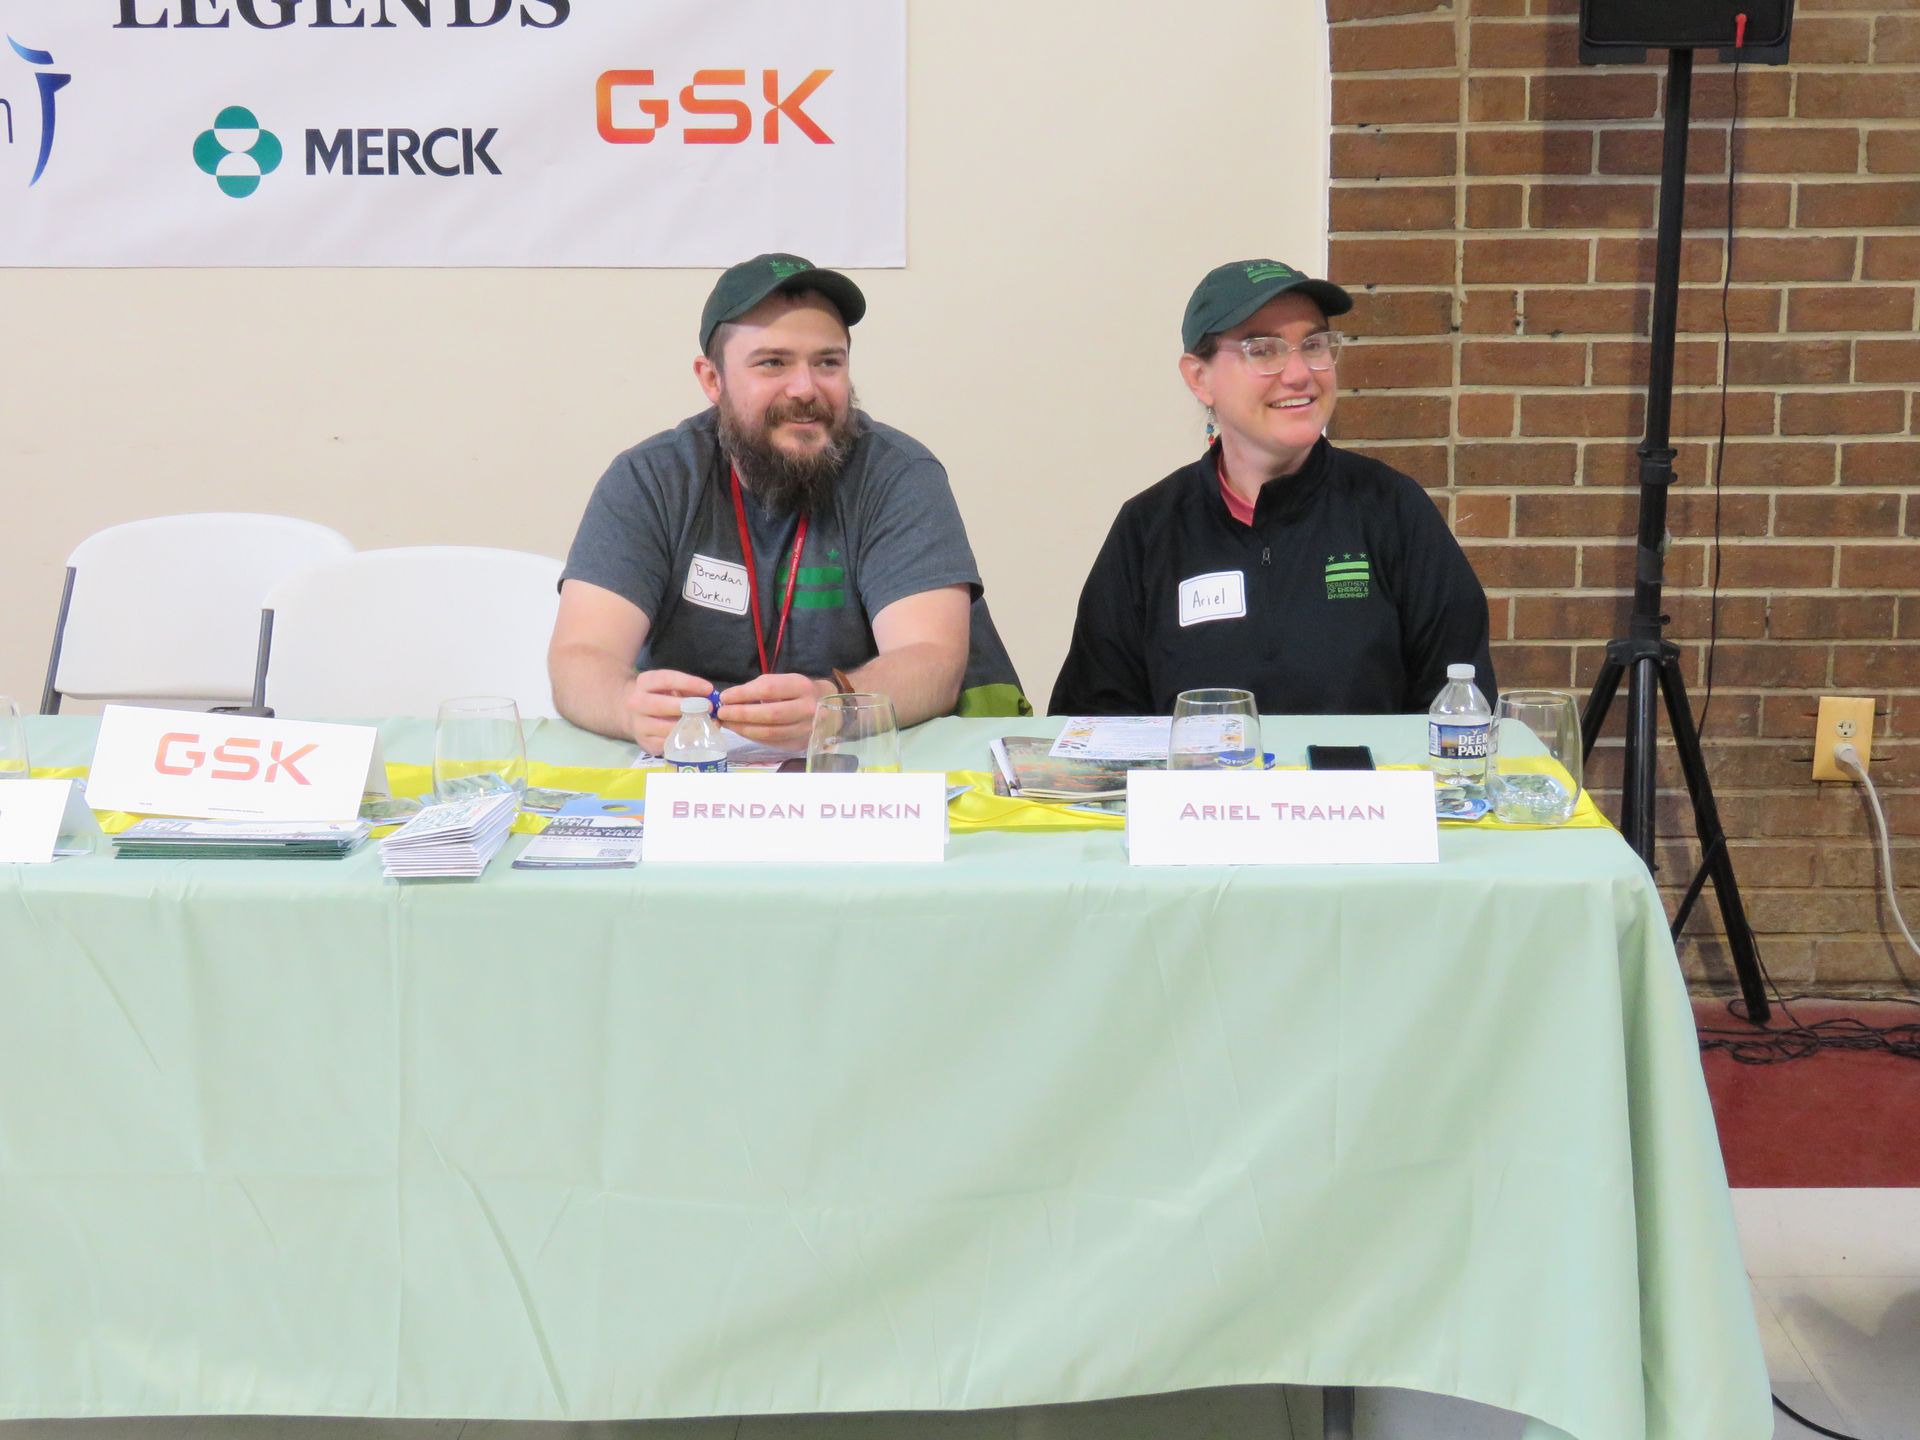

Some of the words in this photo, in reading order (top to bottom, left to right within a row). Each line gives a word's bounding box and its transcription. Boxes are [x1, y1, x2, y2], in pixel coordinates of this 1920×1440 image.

[596, 69, 835, 145] GSK
[305, 127, 502, 177] MERCK
[694, 563, 743, 586] Brendan
[691, 582, 732, 604] Durkin
[1192, 587, 1226, 609] Ariel
[1458, 733, 1488, 745] DEER
[154, 732, 320, 786] GSK
[1457, 745, 1488, 757] PARK
[672, 800, 805, 819] BRENDAN
[1179, 802, 1260, 821] ARIEL
[1271, 802, 1386, 821] TRAHAN
